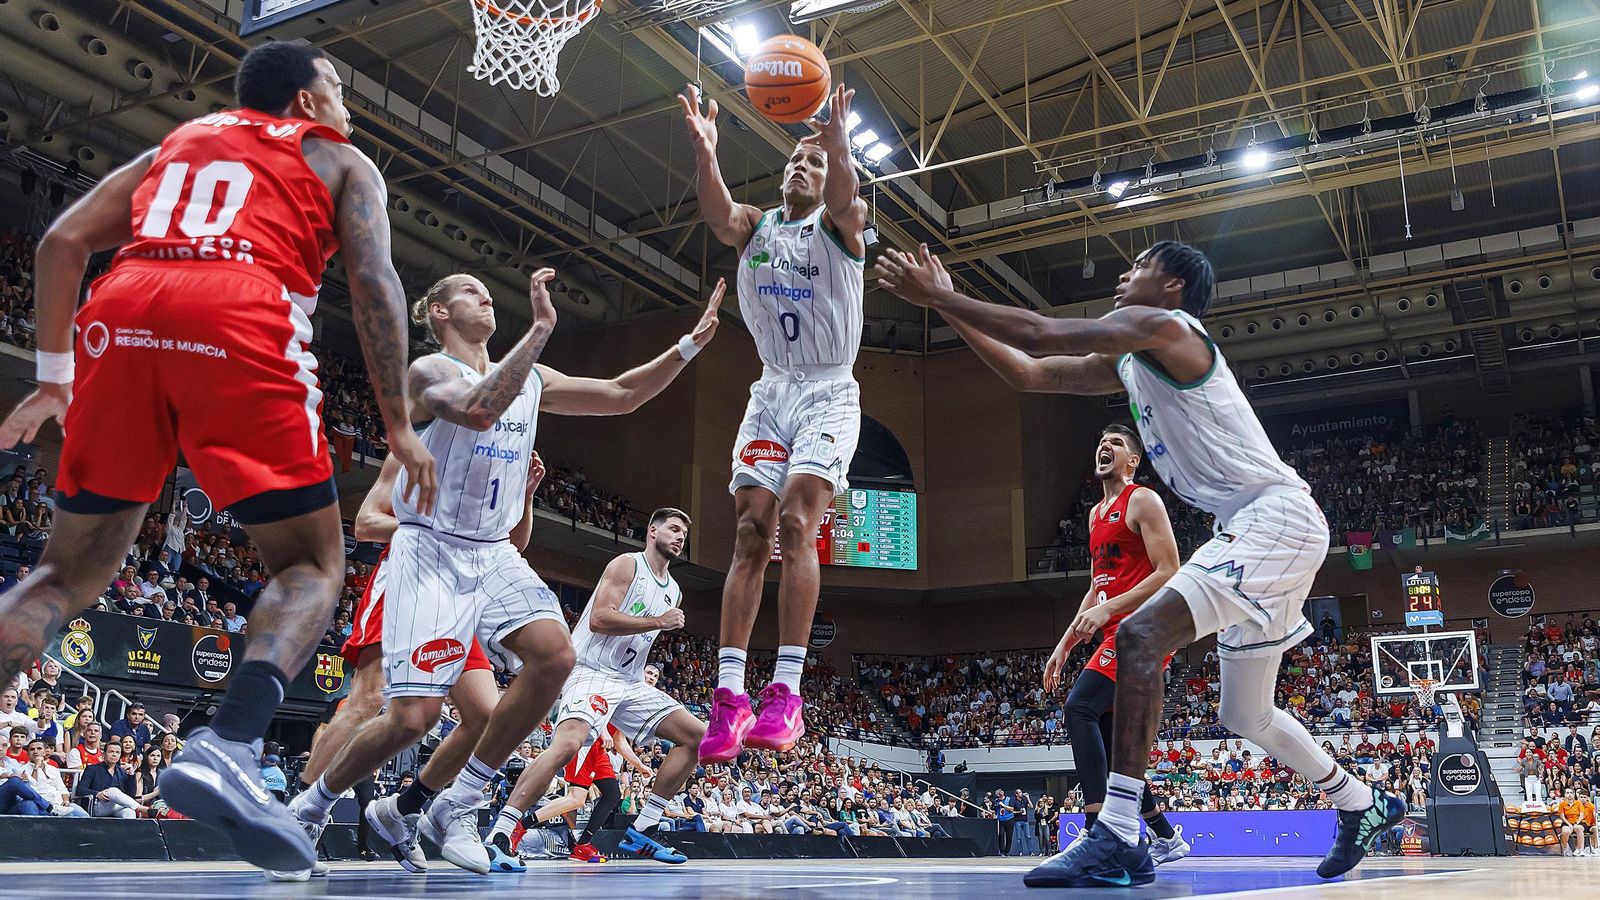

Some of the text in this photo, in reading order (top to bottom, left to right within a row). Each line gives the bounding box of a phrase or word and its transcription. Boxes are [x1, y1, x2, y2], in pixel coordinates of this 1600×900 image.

[750, 60, 803, 78] Wilson
[141, 160, 255, 239] 10
[758, 282, 812, 301] málaga
[780, 312, 800, 342] 0
[115, 335, 228, 359] REGIÓN DE MURCIA
[1291, 415, 1387, 437] Ayuntamiento
[489, 478, 500, 510] 1
[853, 516, 866, 527] 37
[829, 528, 854, 538] 1:04
[1410, 596, 1433, 612] 24
[1496, 596, 1532, 605] endesa
[127, 650, 162, 664] UCAM
[196, 650, 229, 660] supercopa
[198, 658, 229, 668] endesa
[621, 647, 638, 668] 7
